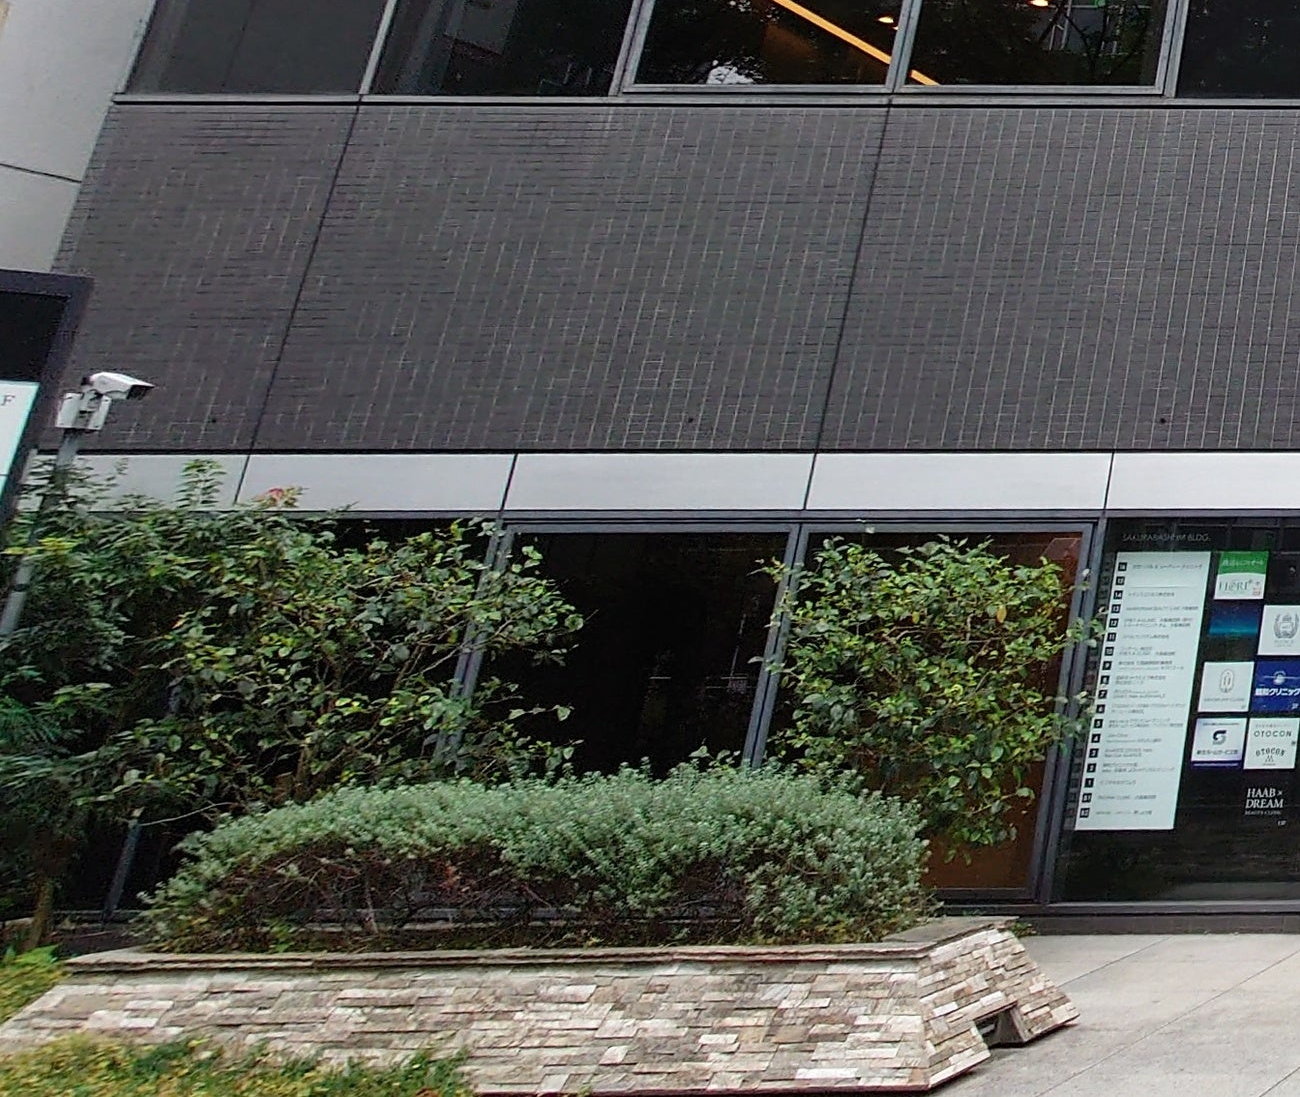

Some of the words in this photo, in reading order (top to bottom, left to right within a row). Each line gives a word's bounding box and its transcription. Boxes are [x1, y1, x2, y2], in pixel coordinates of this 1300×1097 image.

[1254, 730, 1292, 738] OTOCON
[1246, 787, 1276, 798] HAAB
[1245, 798, 1284, 809] DREAM
